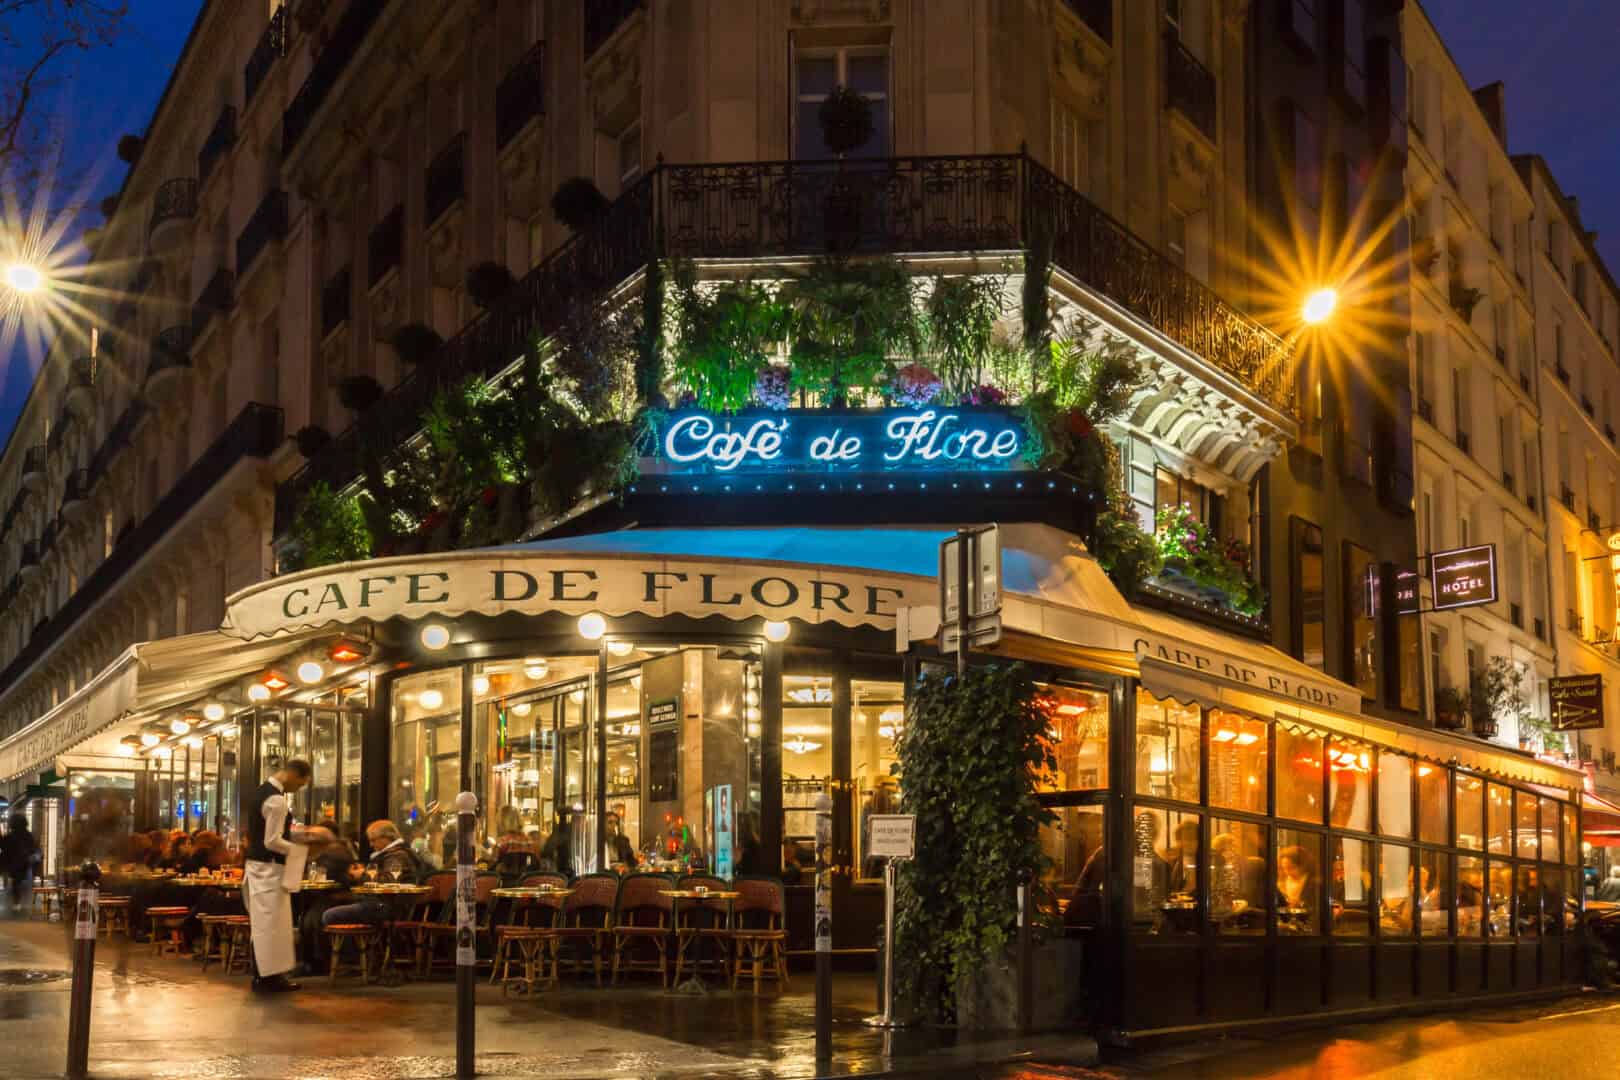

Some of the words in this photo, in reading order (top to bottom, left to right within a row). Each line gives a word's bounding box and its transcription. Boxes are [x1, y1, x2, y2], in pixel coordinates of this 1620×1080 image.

[665, 414, 791, 471] Café
[809, 427, 862, 462] de
[883, 409, 1018, 462] Flore
[283, 571, 450, 618] CAFE
[491, 570, 599, 602] DE
[642, 571, 904, 618] FLORE
[1442, 578, 1485, 593] HOTEL
